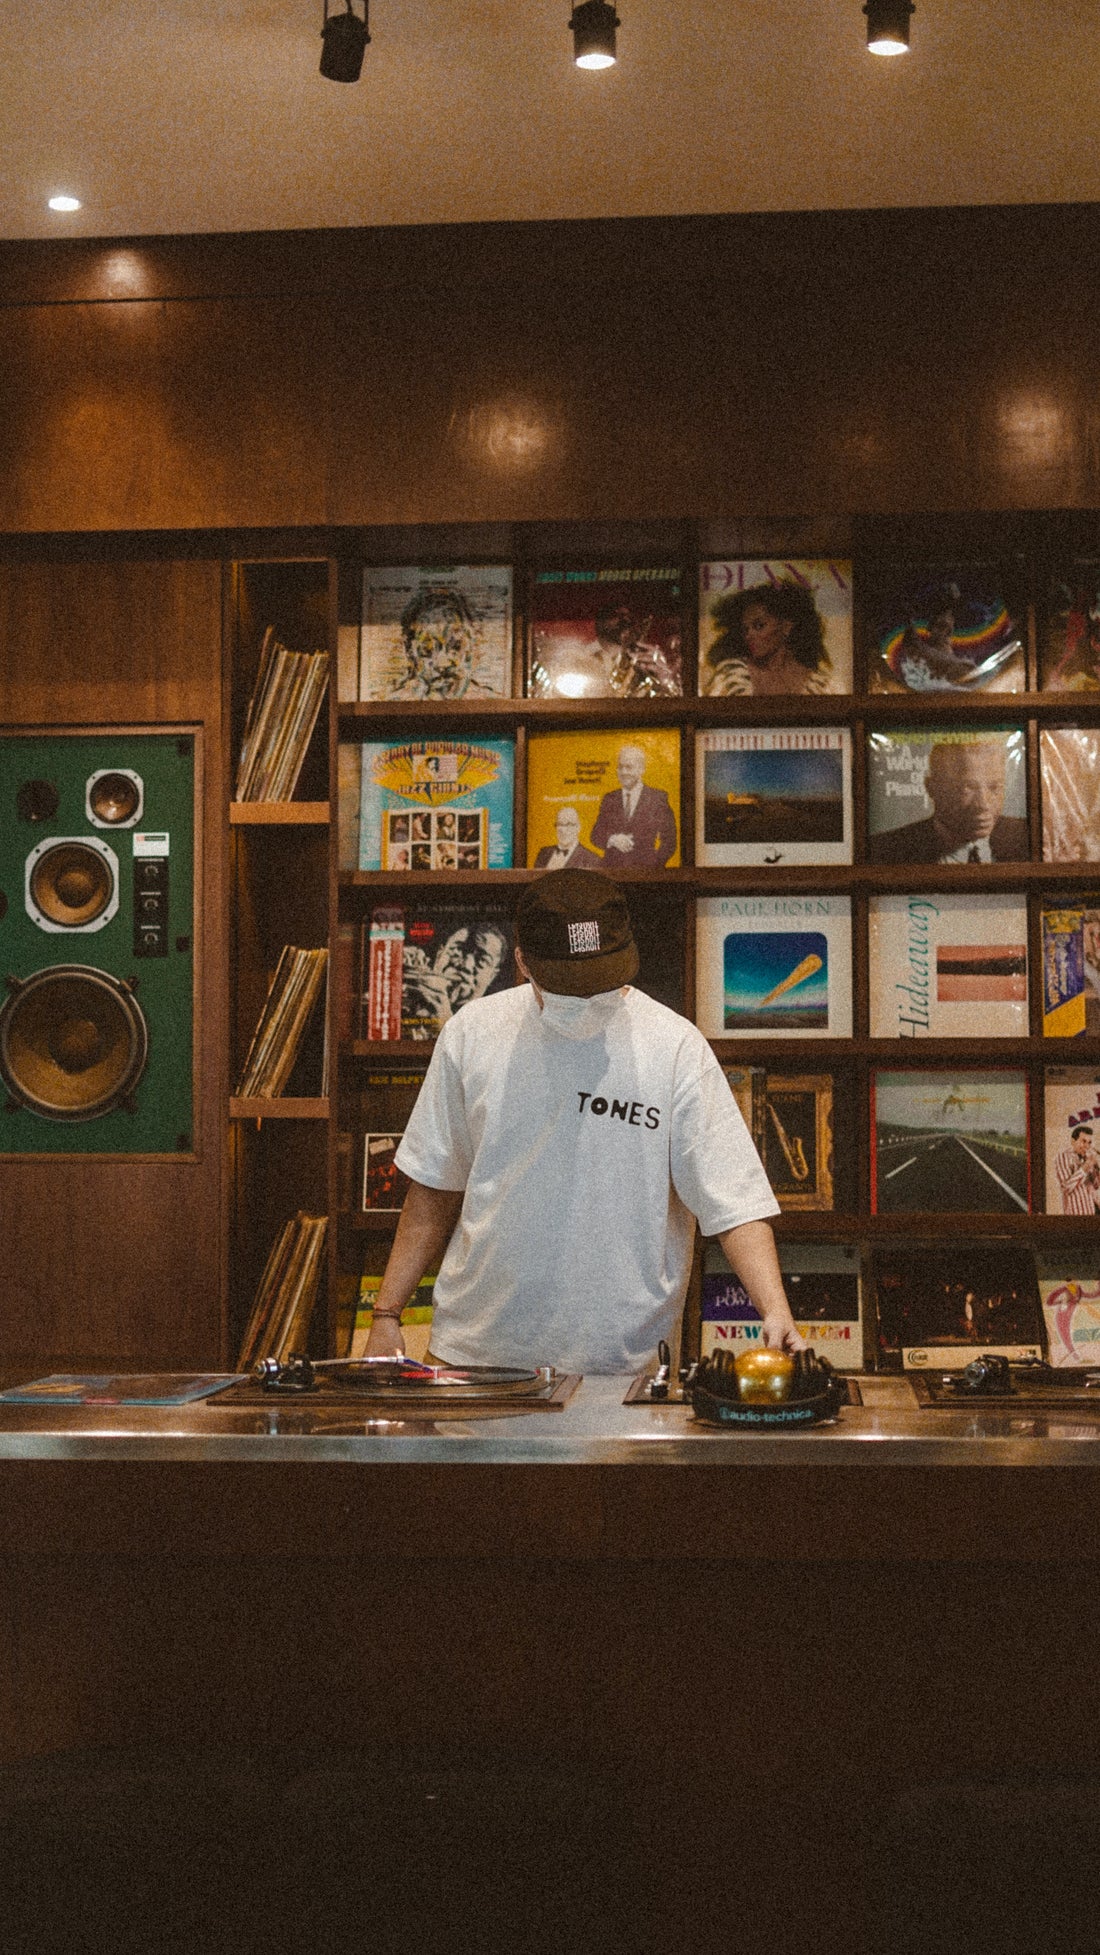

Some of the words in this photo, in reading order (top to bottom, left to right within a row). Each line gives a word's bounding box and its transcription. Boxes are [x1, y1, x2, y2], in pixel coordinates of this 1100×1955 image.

[773, 899, 831, 916] HORN
[898, 896, 940, 1038] Hideaway
[577, 1091, 661, 1131] TONES
[715, 1325, 762, 1340] NEW
[728, 1407, 813, 1422] audio-technica
